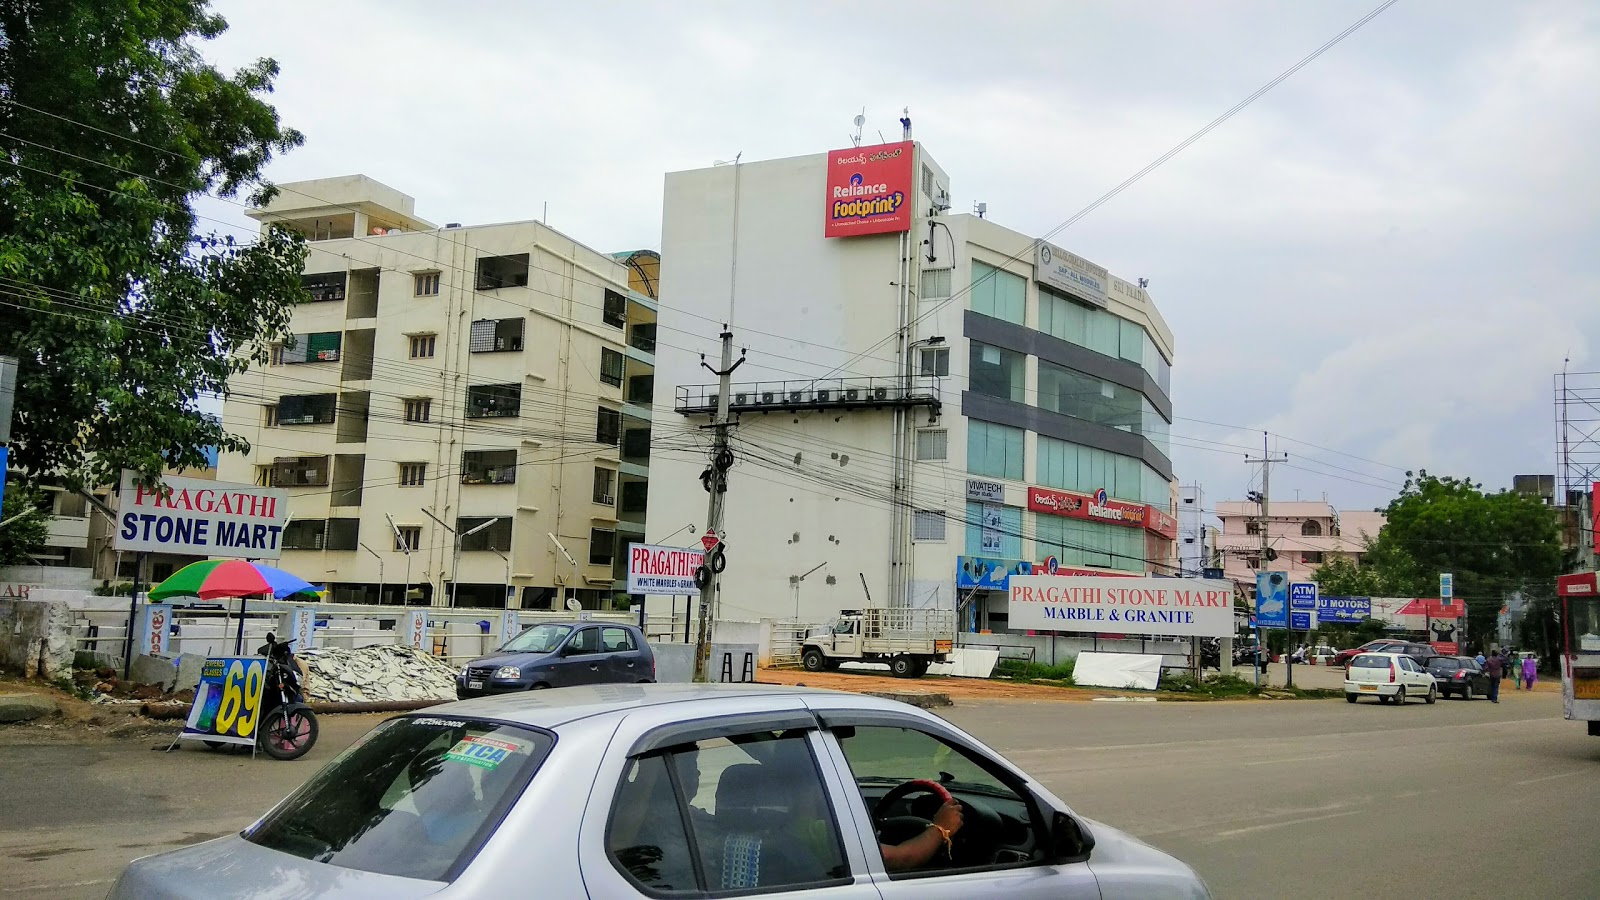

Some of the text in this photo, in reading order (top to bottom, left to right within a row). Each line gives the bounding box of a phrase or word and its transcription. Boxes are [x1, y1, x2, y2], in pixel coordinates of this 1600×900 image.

[833, 183, 887, 198] Reliance
[833, 195, 895, 217] footprint
[968, 480, 1002, 493] VIVATECH
[134, 482, 276, 518] PRAGATHI
[1088, 502, 1121, 520] Reliance
[121, 512, 282, 550] STONE MART
[631, 547, 690, 577] PRAGATHI
[690, 553, 705, 566] STON
[3, 584, 45, 598] AR
[637, 577, 655, 587] WHITE
[1292, 586, 1315, 595] ATM
[1012, 586, 1102, 604] PRAGATHI
[1107, 588, 1169, 606] STONE
[1174, 590, 1231, 608] MART
[1330, 600, 1370, 609] MOTORS
[1043, 606, 1194, 624] MARBLE & GRANITE
[216, 659, 263, 737] 69
[464, 743, 507, 763] TCA
